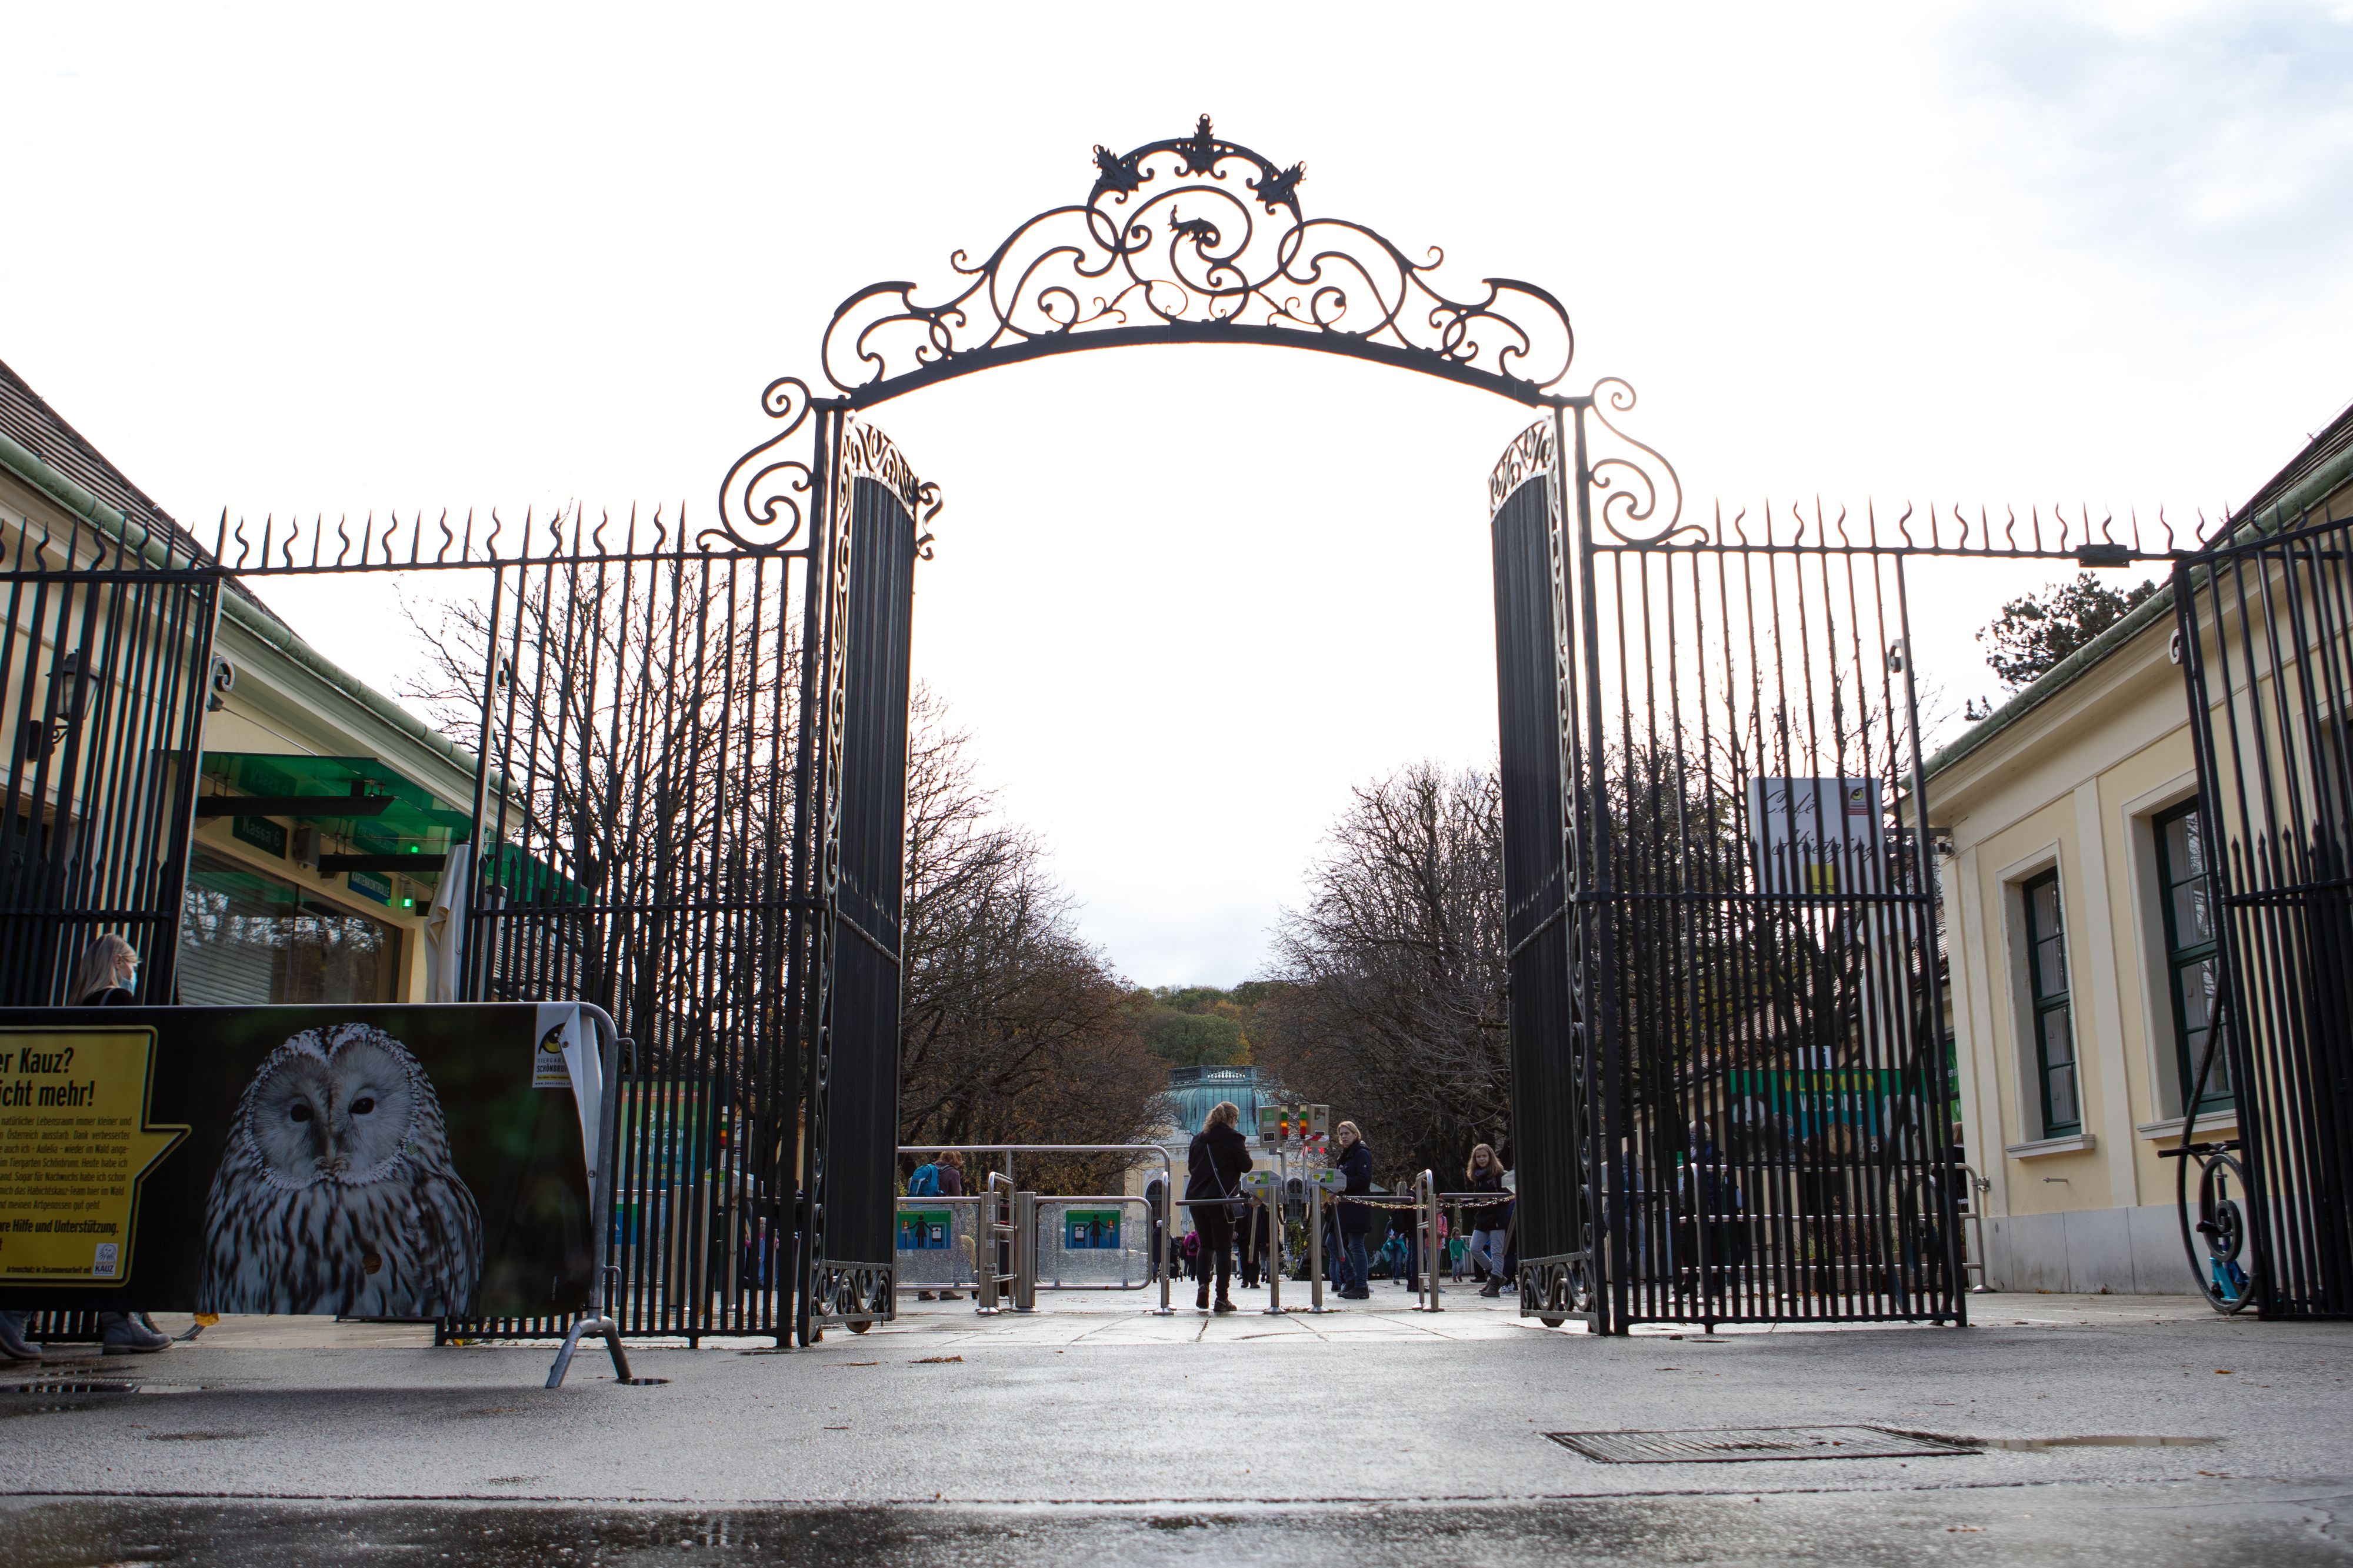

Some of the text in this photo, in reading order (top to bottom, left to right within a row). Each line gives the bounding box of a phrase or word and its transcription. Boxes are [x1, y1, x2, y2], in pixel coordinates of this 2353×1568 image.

[242, 816, 281, 848] Kassa 6
[351, 871, 389, 898] KARTENKONTROLLE
[19, 1047, 74, 1073] Kauz?
[38, 1079, 95, 1106] mehr!
[1, 1116, 35, 1126] natürlicher
[36, 1116, 74, 1126] Lebensraum
[76, 1116, 96, 1126] immer
[119, 1116, 132, 1126] und
[7, 1129, 39, 1140] Österreich
[41, 1130, 70, 1140] ausstarb.
[74, 1130, 89, 1140] Dank
[92, 1130, 131, 1140] verbesserter
[4, 1144, 20, 1153] auch
[21, 1144, 31, 1153] ich
[64, 1144, 85, 1153] wieder
[86, 1144, 94, 1153] im
[95, 1144, 110, 1153] Wald
[9, 1157, 42, 1169] Tiergarten
[42, 1157, 80, 1168] Schönbrunn.
[81, 1158, 100, 1168] Heute
[101, 1158, 117, 1167] habe
[118, 1158, 128, 1167] ich
[15, 1171, 34, 1183] Sogar
[34, 1172, 44, 1182] für
[45, 1172, 79, 1182] Nachwuchs
[79, 1172, 95, 1182] habe
[96, 1172, 106, 1182] ich
[108, 1172, 126, 1182] schon
[14, 1185, 26, 1196] das
[86, 1185, 99, 1195] hier
[101, 1186, 109, 1195] im
[110, 1186, 125, 1196] Wald
[8, 1199, 32, 1209] meinen
[32, 1199, 72, 1212] Artgenossen
[73, 1200, 85, 1212] gut
[85, 1200, 102, 1212] geht.
[12, 1219, 34, 1233] Hilfe
[35, 1219, 54, 1233] und
[54, 1219, 119, 1236] Unterstützung.
[94, 1265, 114, 1273] KAUZ
